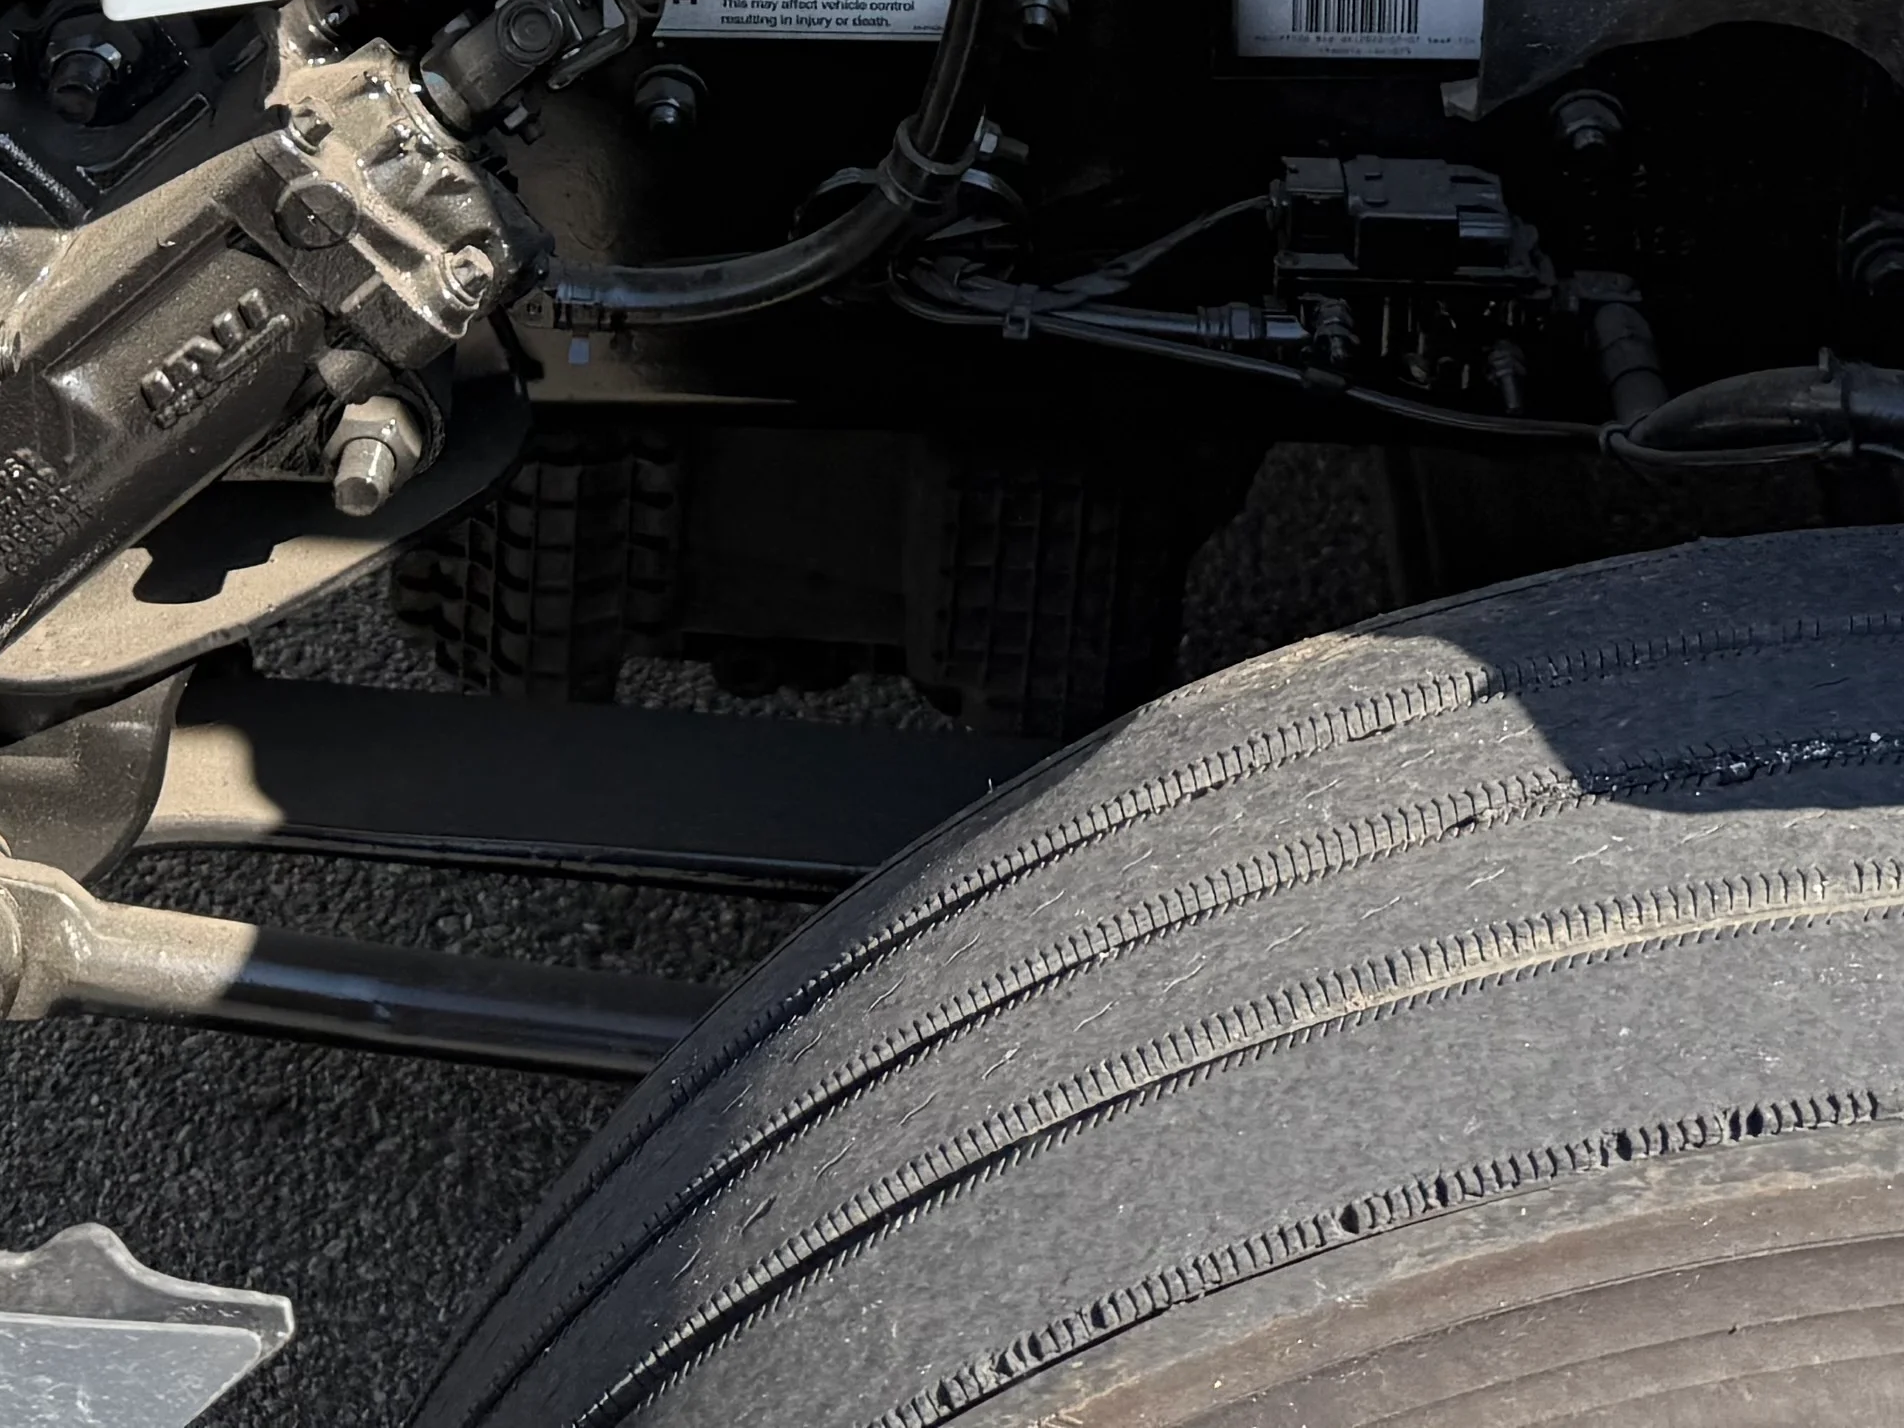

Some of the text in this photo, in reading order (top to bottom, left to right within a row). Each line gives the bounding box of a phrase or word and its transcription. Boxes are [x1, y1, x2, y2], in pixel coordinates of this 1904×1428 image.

[751, 0, 778, 12] may
[821, 0, 868, 11] vehicle
[869, 0, 915, 11] control
[721, 14, 892, 29] resulting in injury or death.
